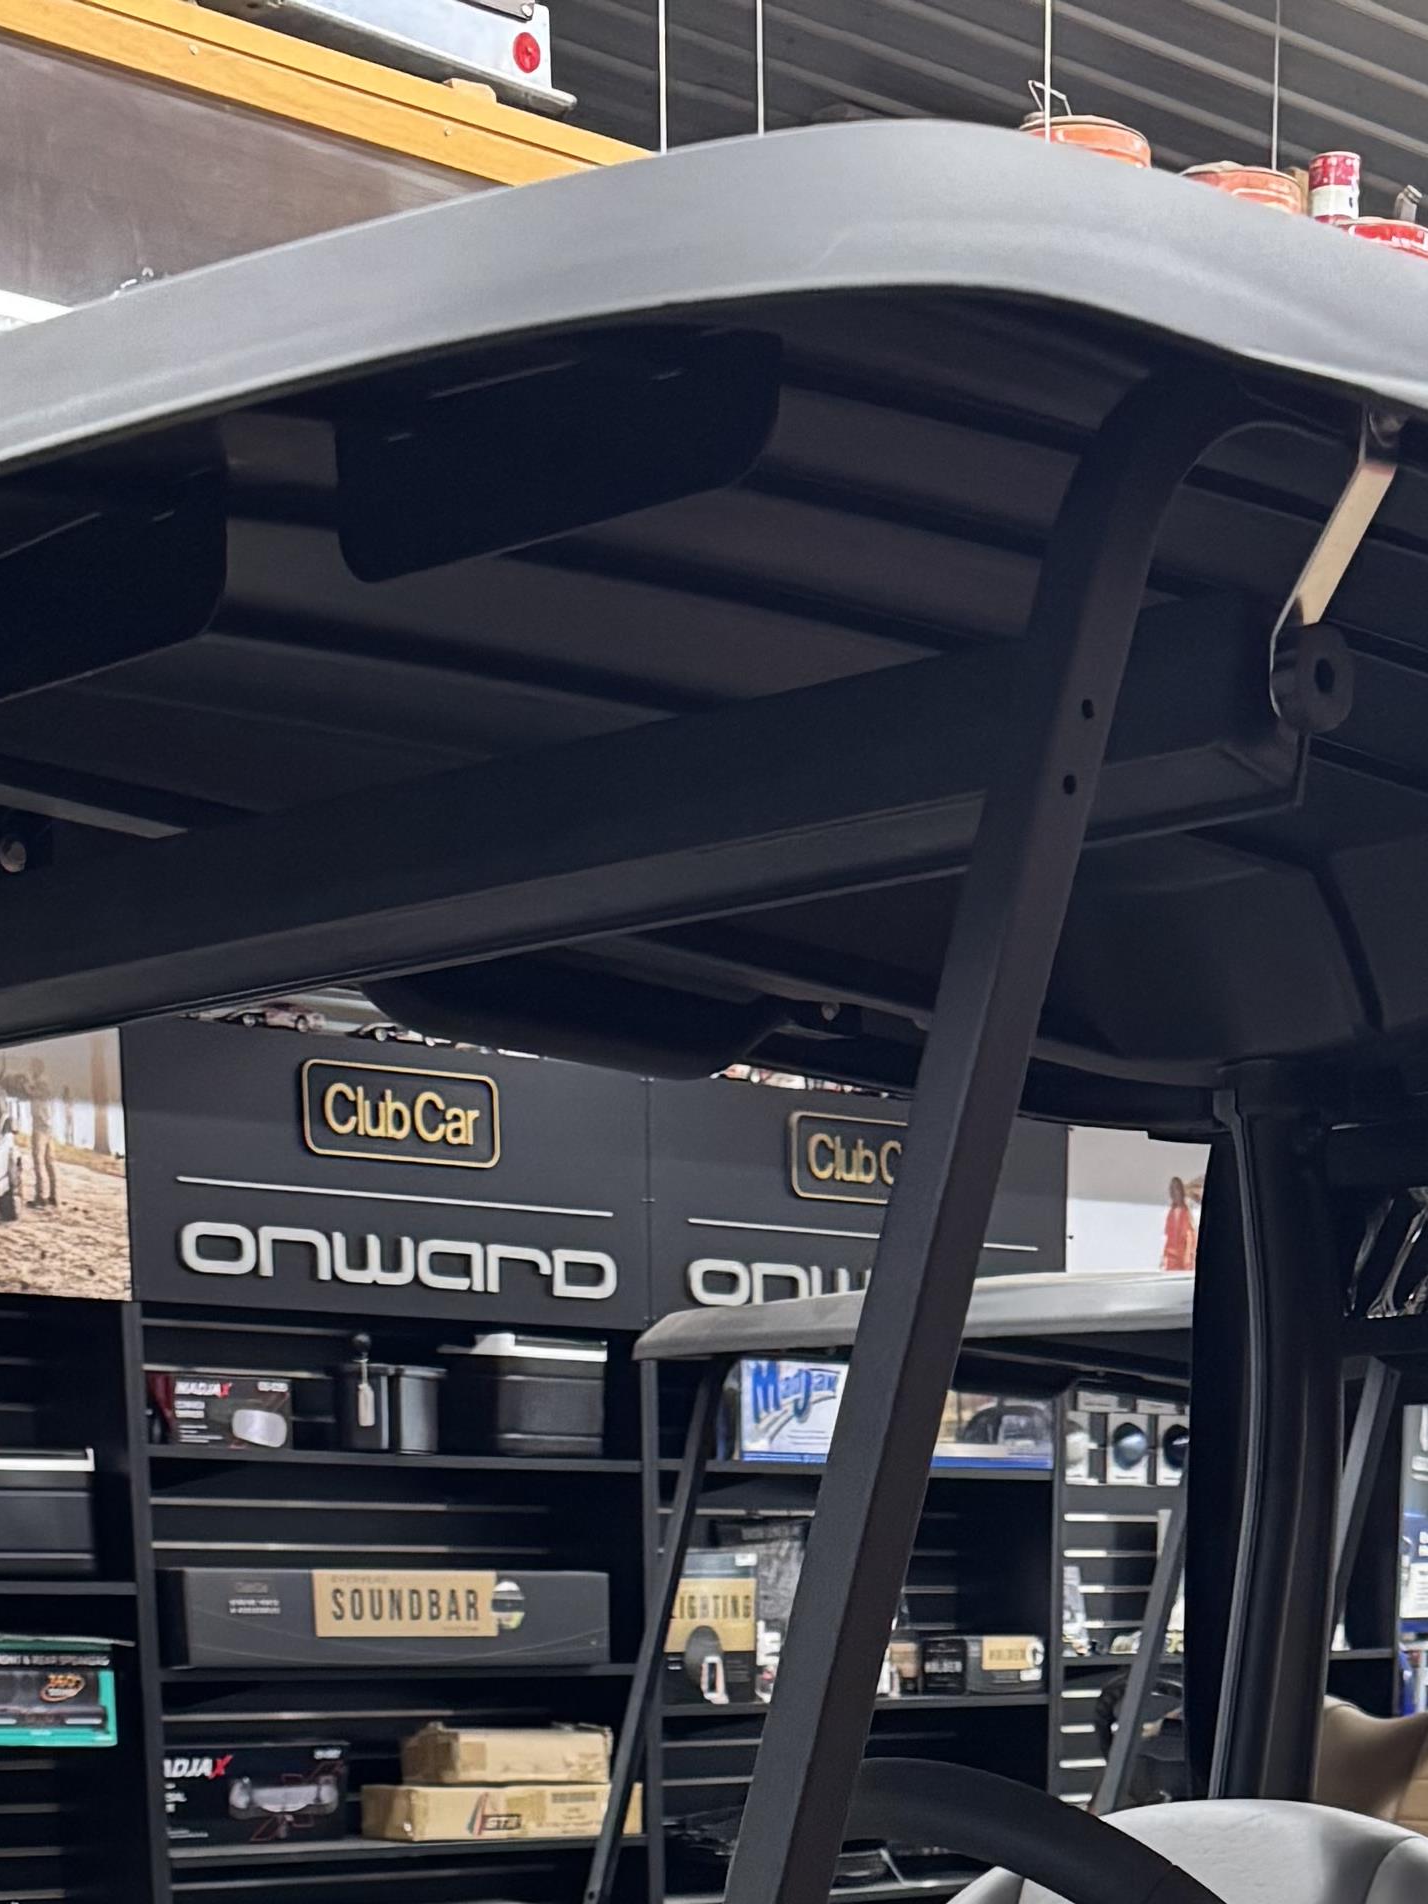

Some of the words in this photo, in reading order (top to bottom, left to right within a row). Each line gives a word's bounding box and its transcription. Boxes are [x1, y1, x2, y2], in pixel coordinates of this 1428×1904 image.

[324, 1082, 411, 1140] Club
[413, 1091, 481, 1146] Car
[807, 1132, 877, 1185] Club
[331, 1588, 480, 1622] SOUNDBAR
[676, 1594, 753, 1620] IGHTING
[163, 1753, 234, 1780] DJAX
